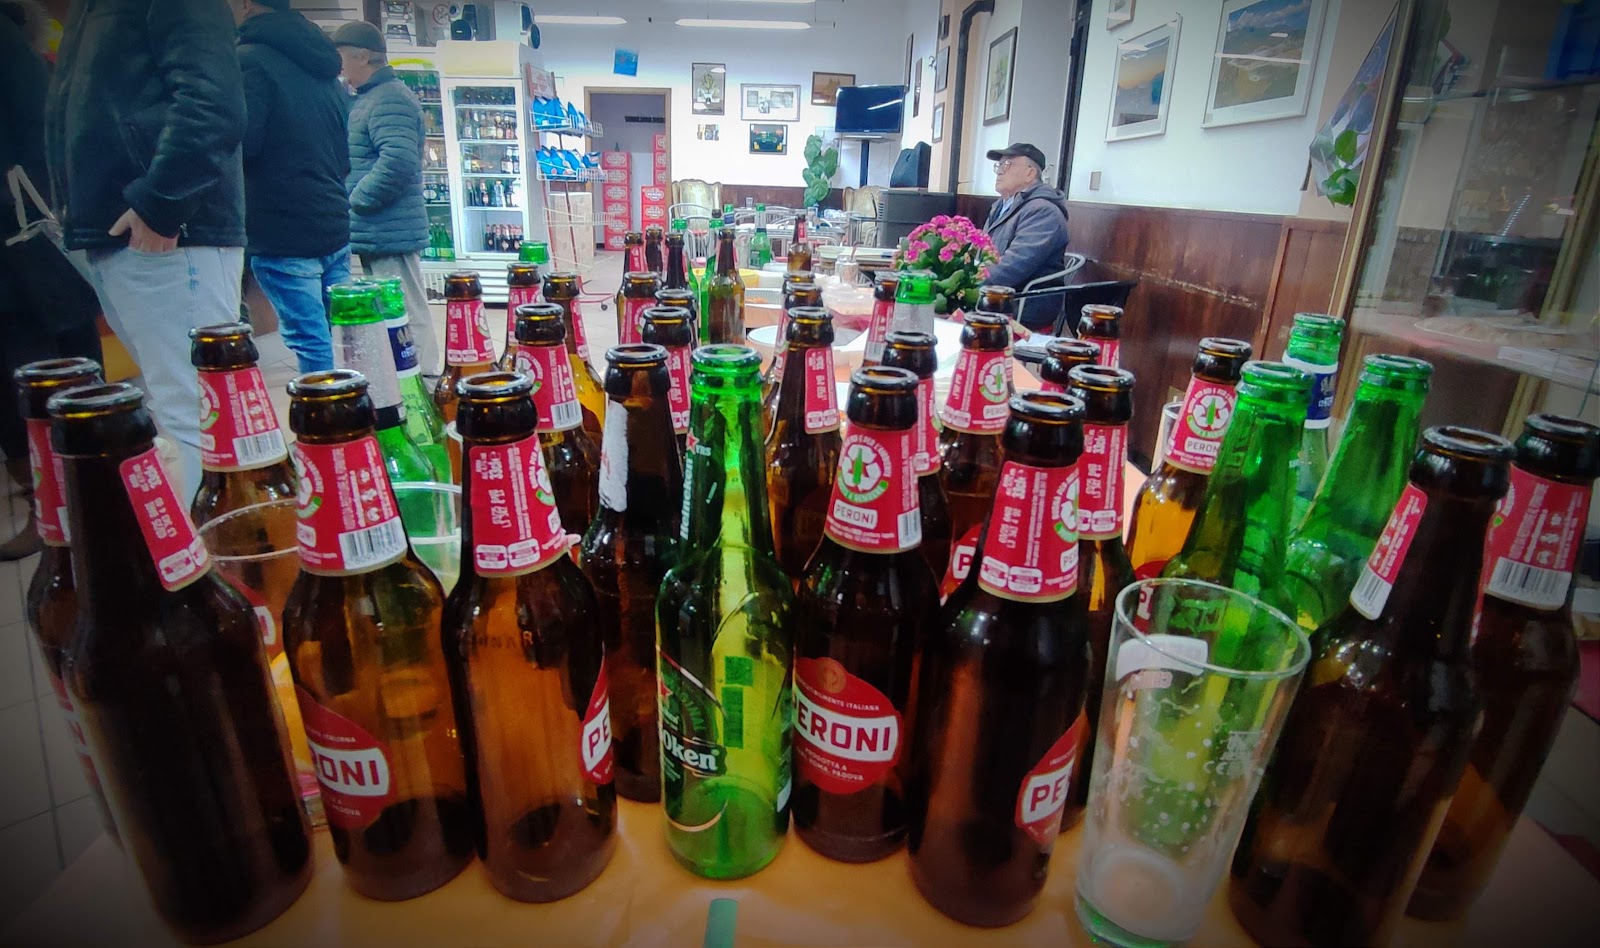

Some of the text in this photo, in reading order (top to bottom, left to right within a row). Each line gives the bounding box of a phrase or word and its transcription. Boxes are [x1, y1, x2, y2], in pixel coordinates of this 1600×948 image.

[680, 458, 693, 541] Heineken
[836, 504, 874, 524] PERONI
[792, 692, 891, 753] ERONI
[309, 745, 381, 787] ONI
